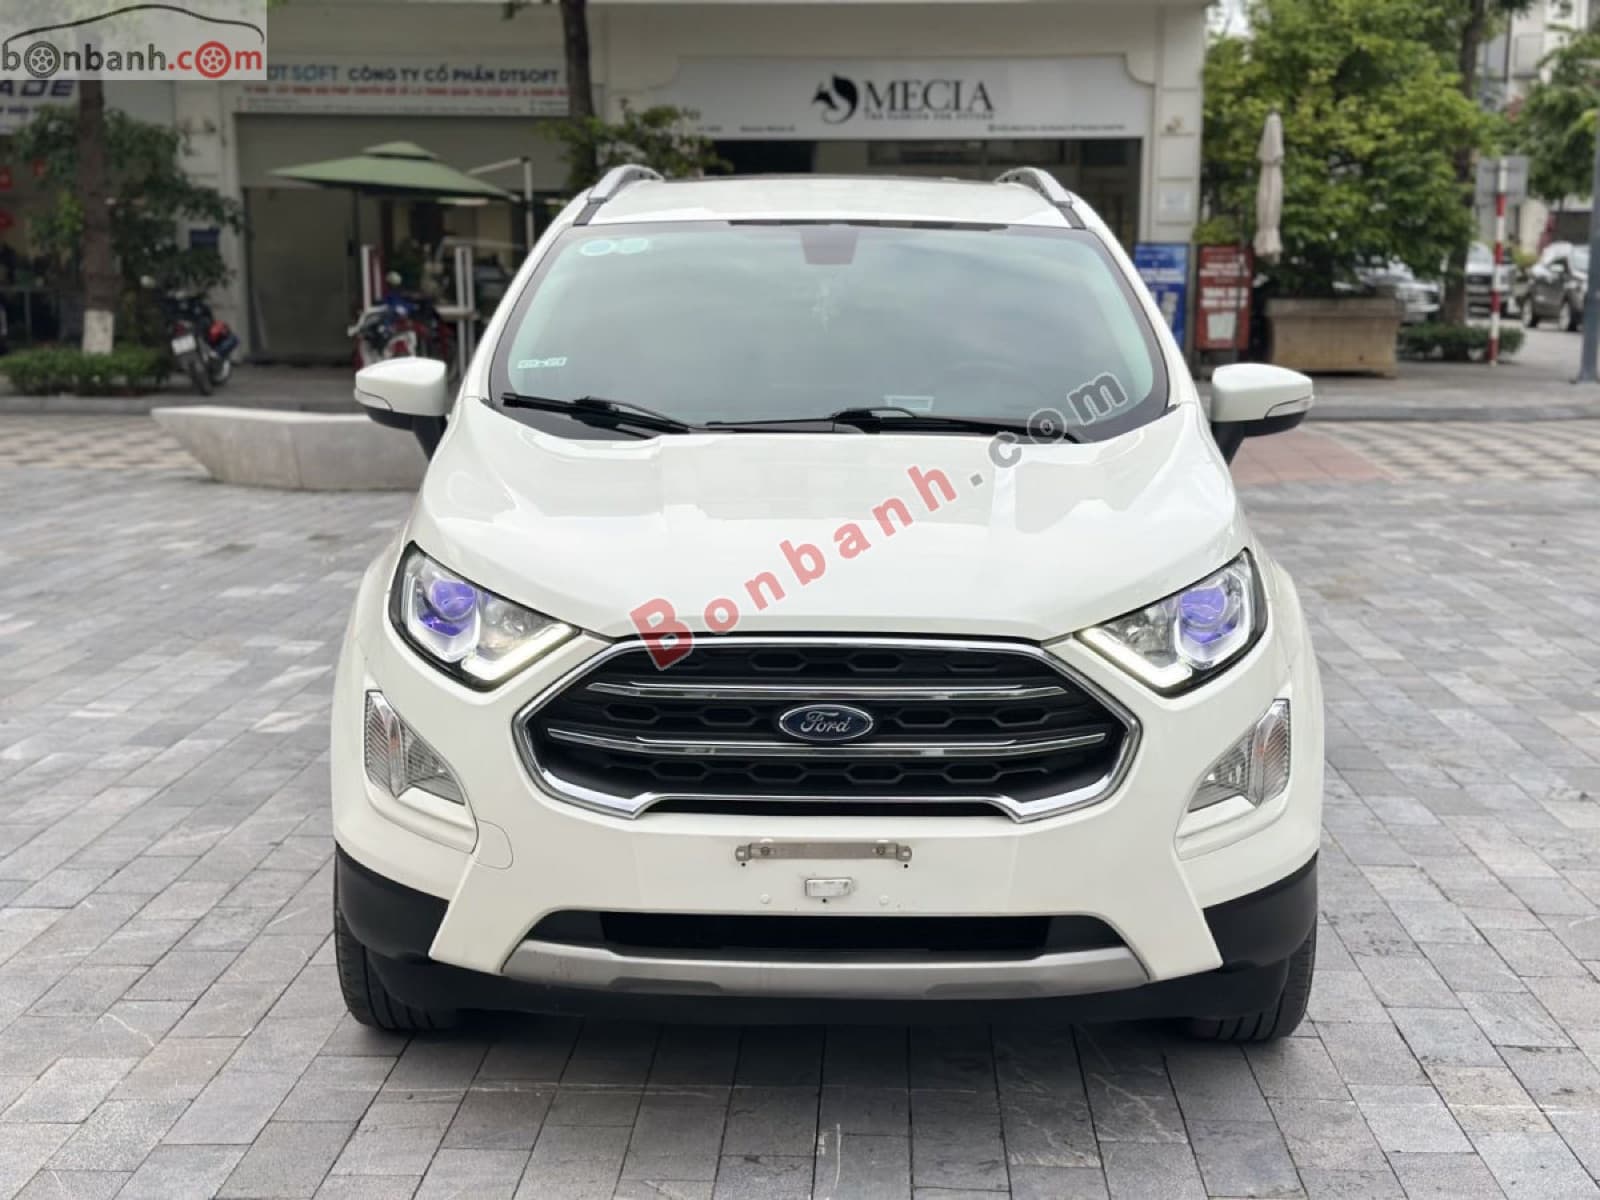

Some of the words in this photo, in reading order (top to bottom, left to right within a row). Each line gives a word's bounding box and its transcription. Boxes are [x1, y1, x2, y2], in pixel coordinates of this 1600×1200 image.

[291, 64, 338, 81] SOFT
[401, 67, 420, 81] TY
[864, 80, 993, 112] MECIA
[800, 710, 851, 733] Ford
